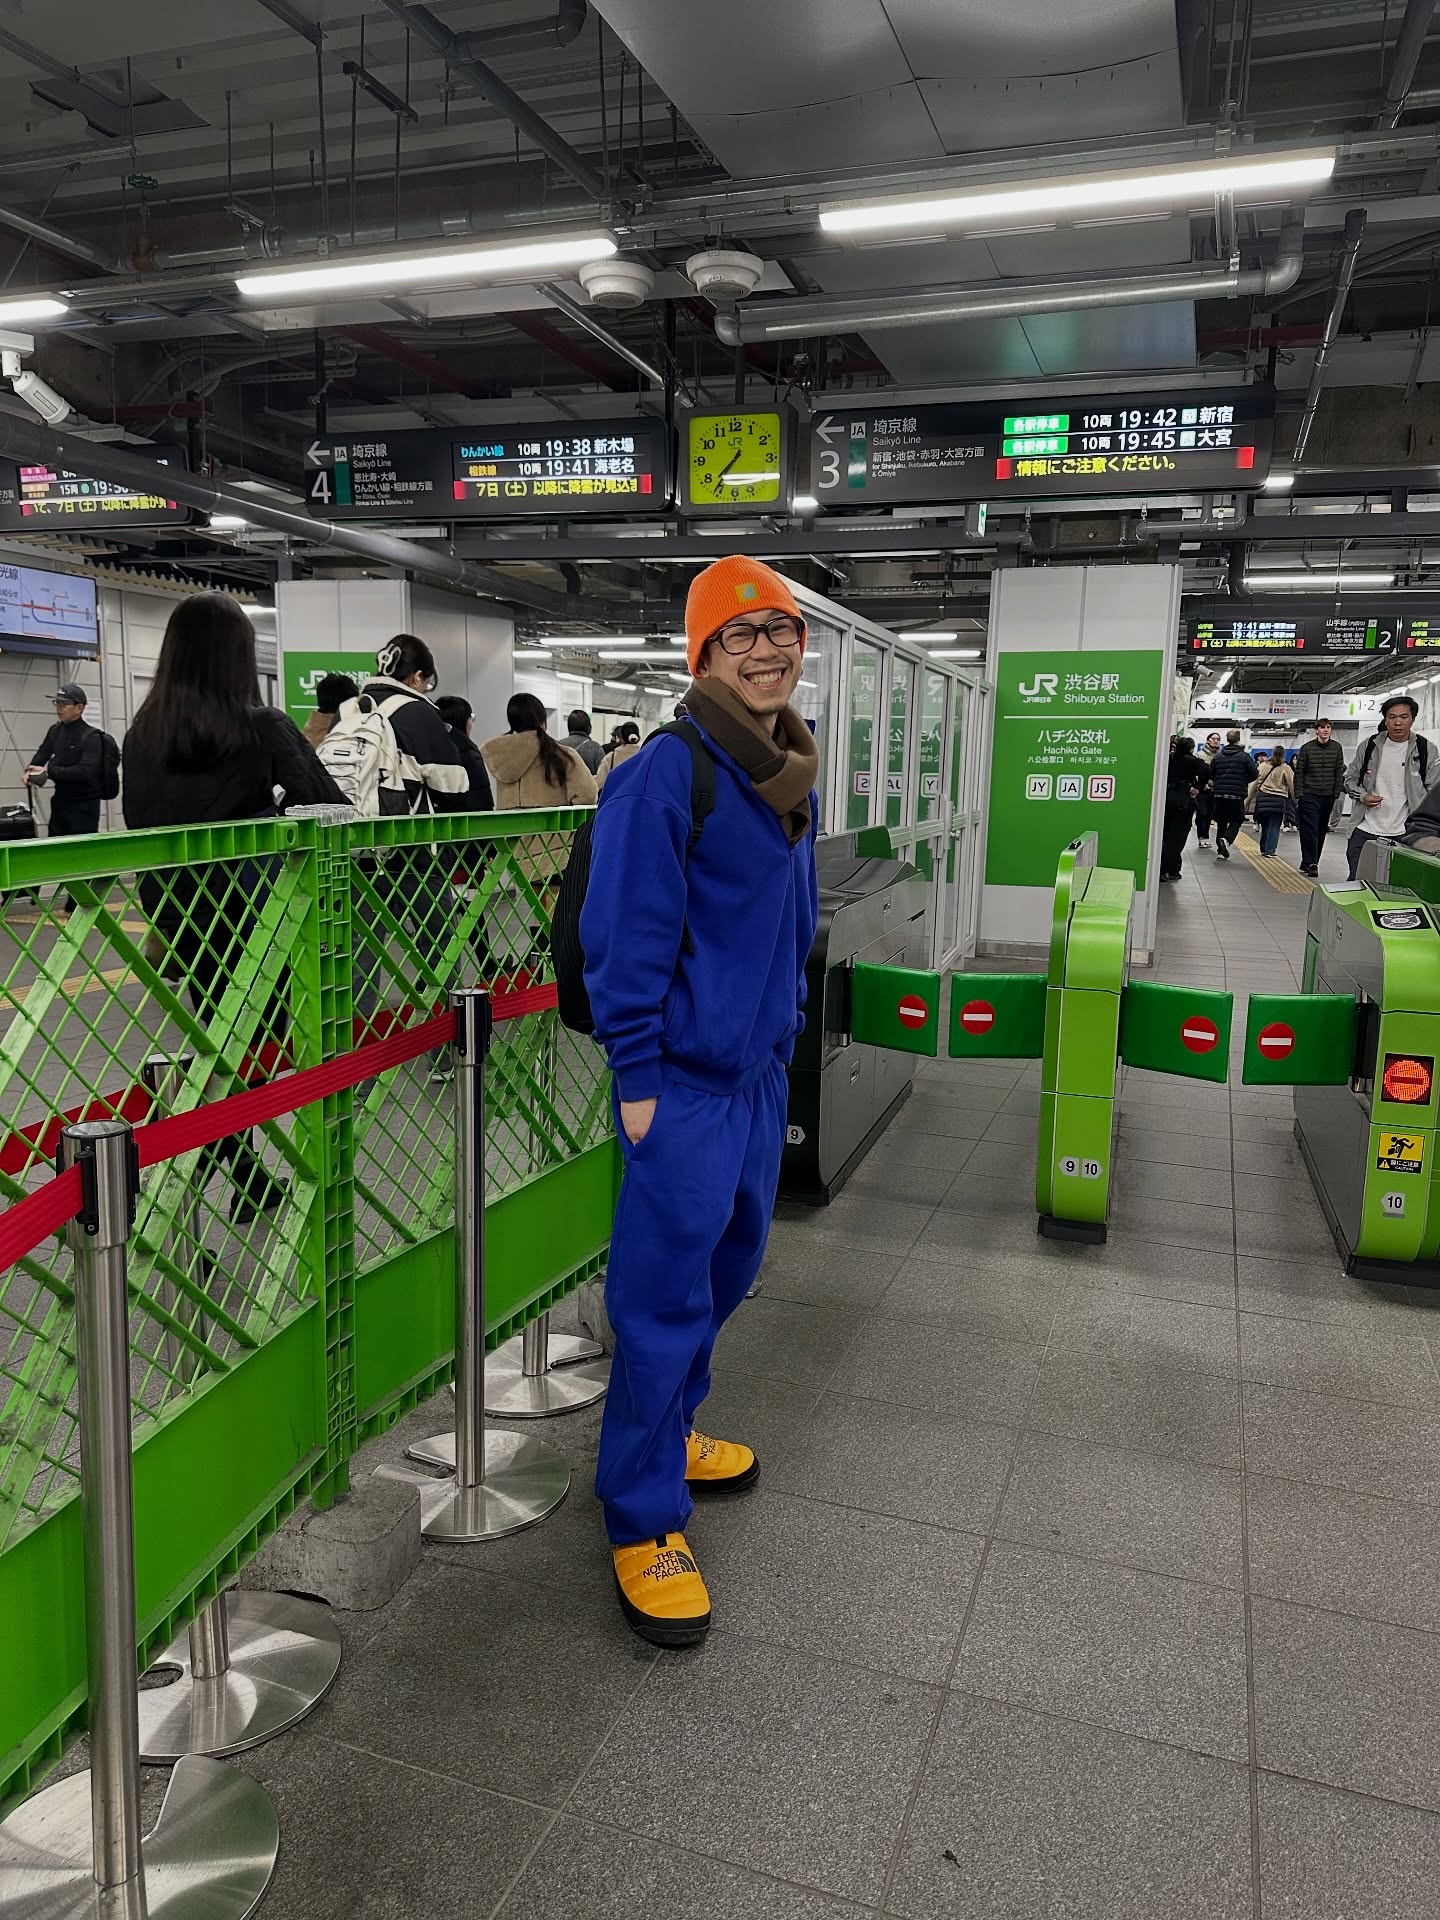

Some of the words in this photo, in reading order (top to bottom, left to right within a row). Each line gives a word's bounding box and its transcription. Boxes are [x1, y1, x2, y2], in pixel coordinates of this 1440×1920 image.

[1083, 414, 1111, 428] 10両
[1119, 408, 1177, 428] 19:42
[1199, 406, 1234, 424] 新宿
[729, 421, 742, 432] 12
[748, 425, 753, 435] 1
[852, 425, 865, 436] JA
[873, 417, 917, 434] 埼京線
[715, 427, 726, 437] 11
[703, 440, 716, 450] 10
[759, 436, 768, 446] 2
[903, 436, 922, 445] Line
[1081, 436, 1110, 450] 10両
[1118, 430, 1176, 451] 19:45
[1197, 428, 1232, 446] 大宮
[352, 443, 388, 458] 埼京線
[517, 443, 541, 456] 10両
[546, 438, 591, 457] 19:38
[594, 437, 635, 454] 新木場
[377, 459, 392, 467] Line
[697, 456, 706, 466] 9
[766, 453, 774, 463] 3
[518, 463, 542, 476] 10両
[546, 458, 590, 476] 19:41
[594, 458, 635, 474] 海老名
[818, 451, 840, 489] 3
[1014, 455, 1176, 477] 情報にご注意ください。
[704, 473, 712, 484] 8
[311, 471, 332, 504] 4
[1379, 631, 1392, 648] 2
[1018, 673, 1059, 696] JR
[1064, 673, 1120, 692] 渋谷駅
[1064, 693, 1105, 706] Shibuya
[1108, 693, 1145, 704] Station
[1037, 729, 1111, 744] ハチ公改札
[1043, 746, 1078, 755] Hachikō
[1081, 746, 1102, 755] Gate
[1031, 781, 1047, 793] JY
[1062, 782, 1078, 793] JA
[1094, 782, 1108, 794] JS
[789, 1129, 799, 1140] 9
[1066, 1160, 1075, 1172] 9
[1085, 1163, 1098, 1175] 10
[1387, 1195, 1403, 1209] 10
[655, 1550, 675, 1562] THE
[643, 1558, 679, 1578] NORTH
[655, 1566, 681, 1581] FACE
